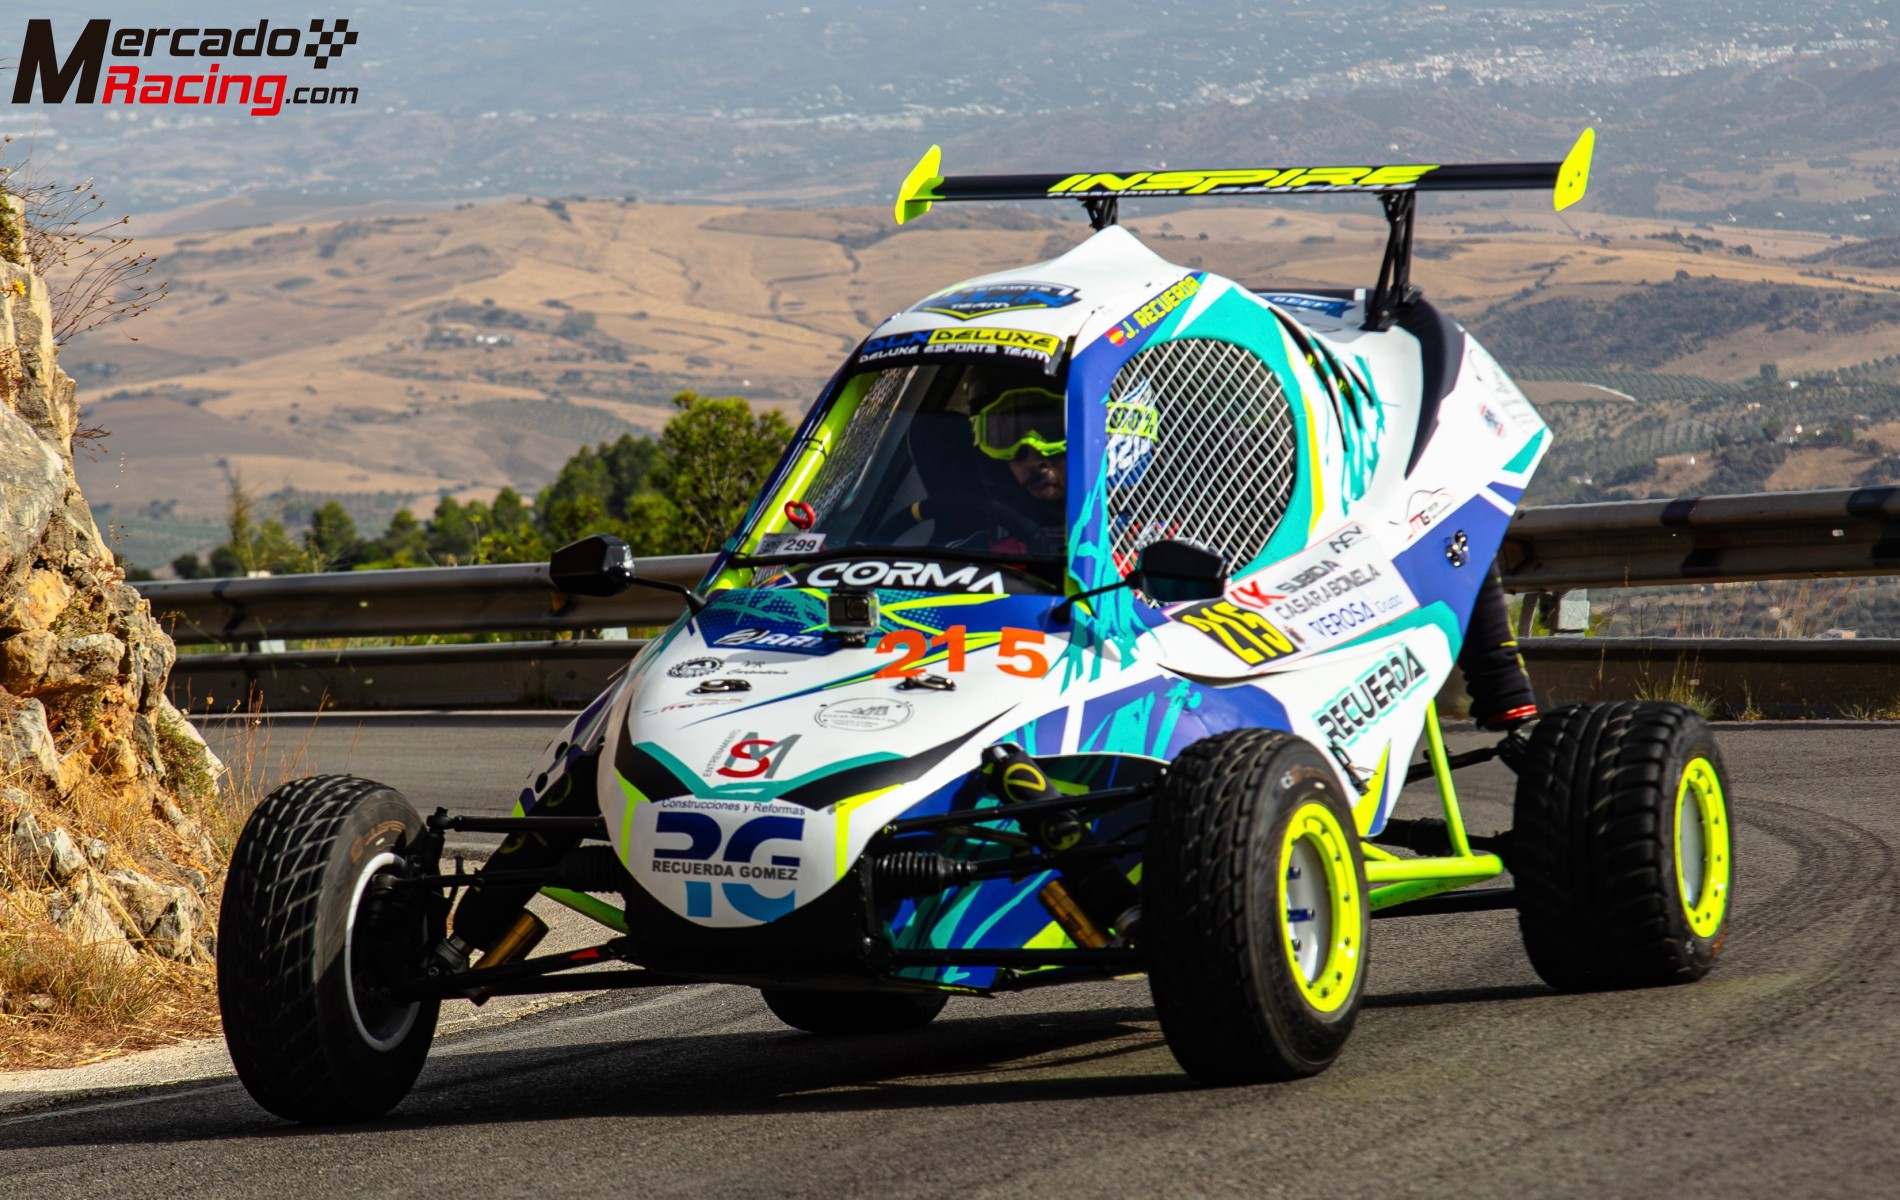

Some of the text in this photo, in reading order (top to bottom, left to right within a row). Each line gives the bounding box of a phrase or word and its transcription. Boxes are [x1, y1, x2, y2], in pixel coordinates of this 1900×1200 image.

[1047, 165, 1440, 195] INSPIRE
[1133, 275, 1202, 330] RECUERDA
[859, 343, 1051, 364] DELUXE ESPORTS TEAM
[934, 329, 1054, 349] DELUXE
[783, 538, 817, 552] 299
[806, 561, 1005, 594] CORMA
[1274, 563, 1383, 621] CASARABONELA
[1275, 559, 1342, 594] SUBIDA
[1182, 601, 1294, 665] 215
[1307, 600, 1376, 638] VEROSA
[1315, 644, 1427, 742] RECUERDA
[661, 798, 806, 816] Construcciones y Reformas
[651, 859, 799, 881] RECUERDA GOMEZ
